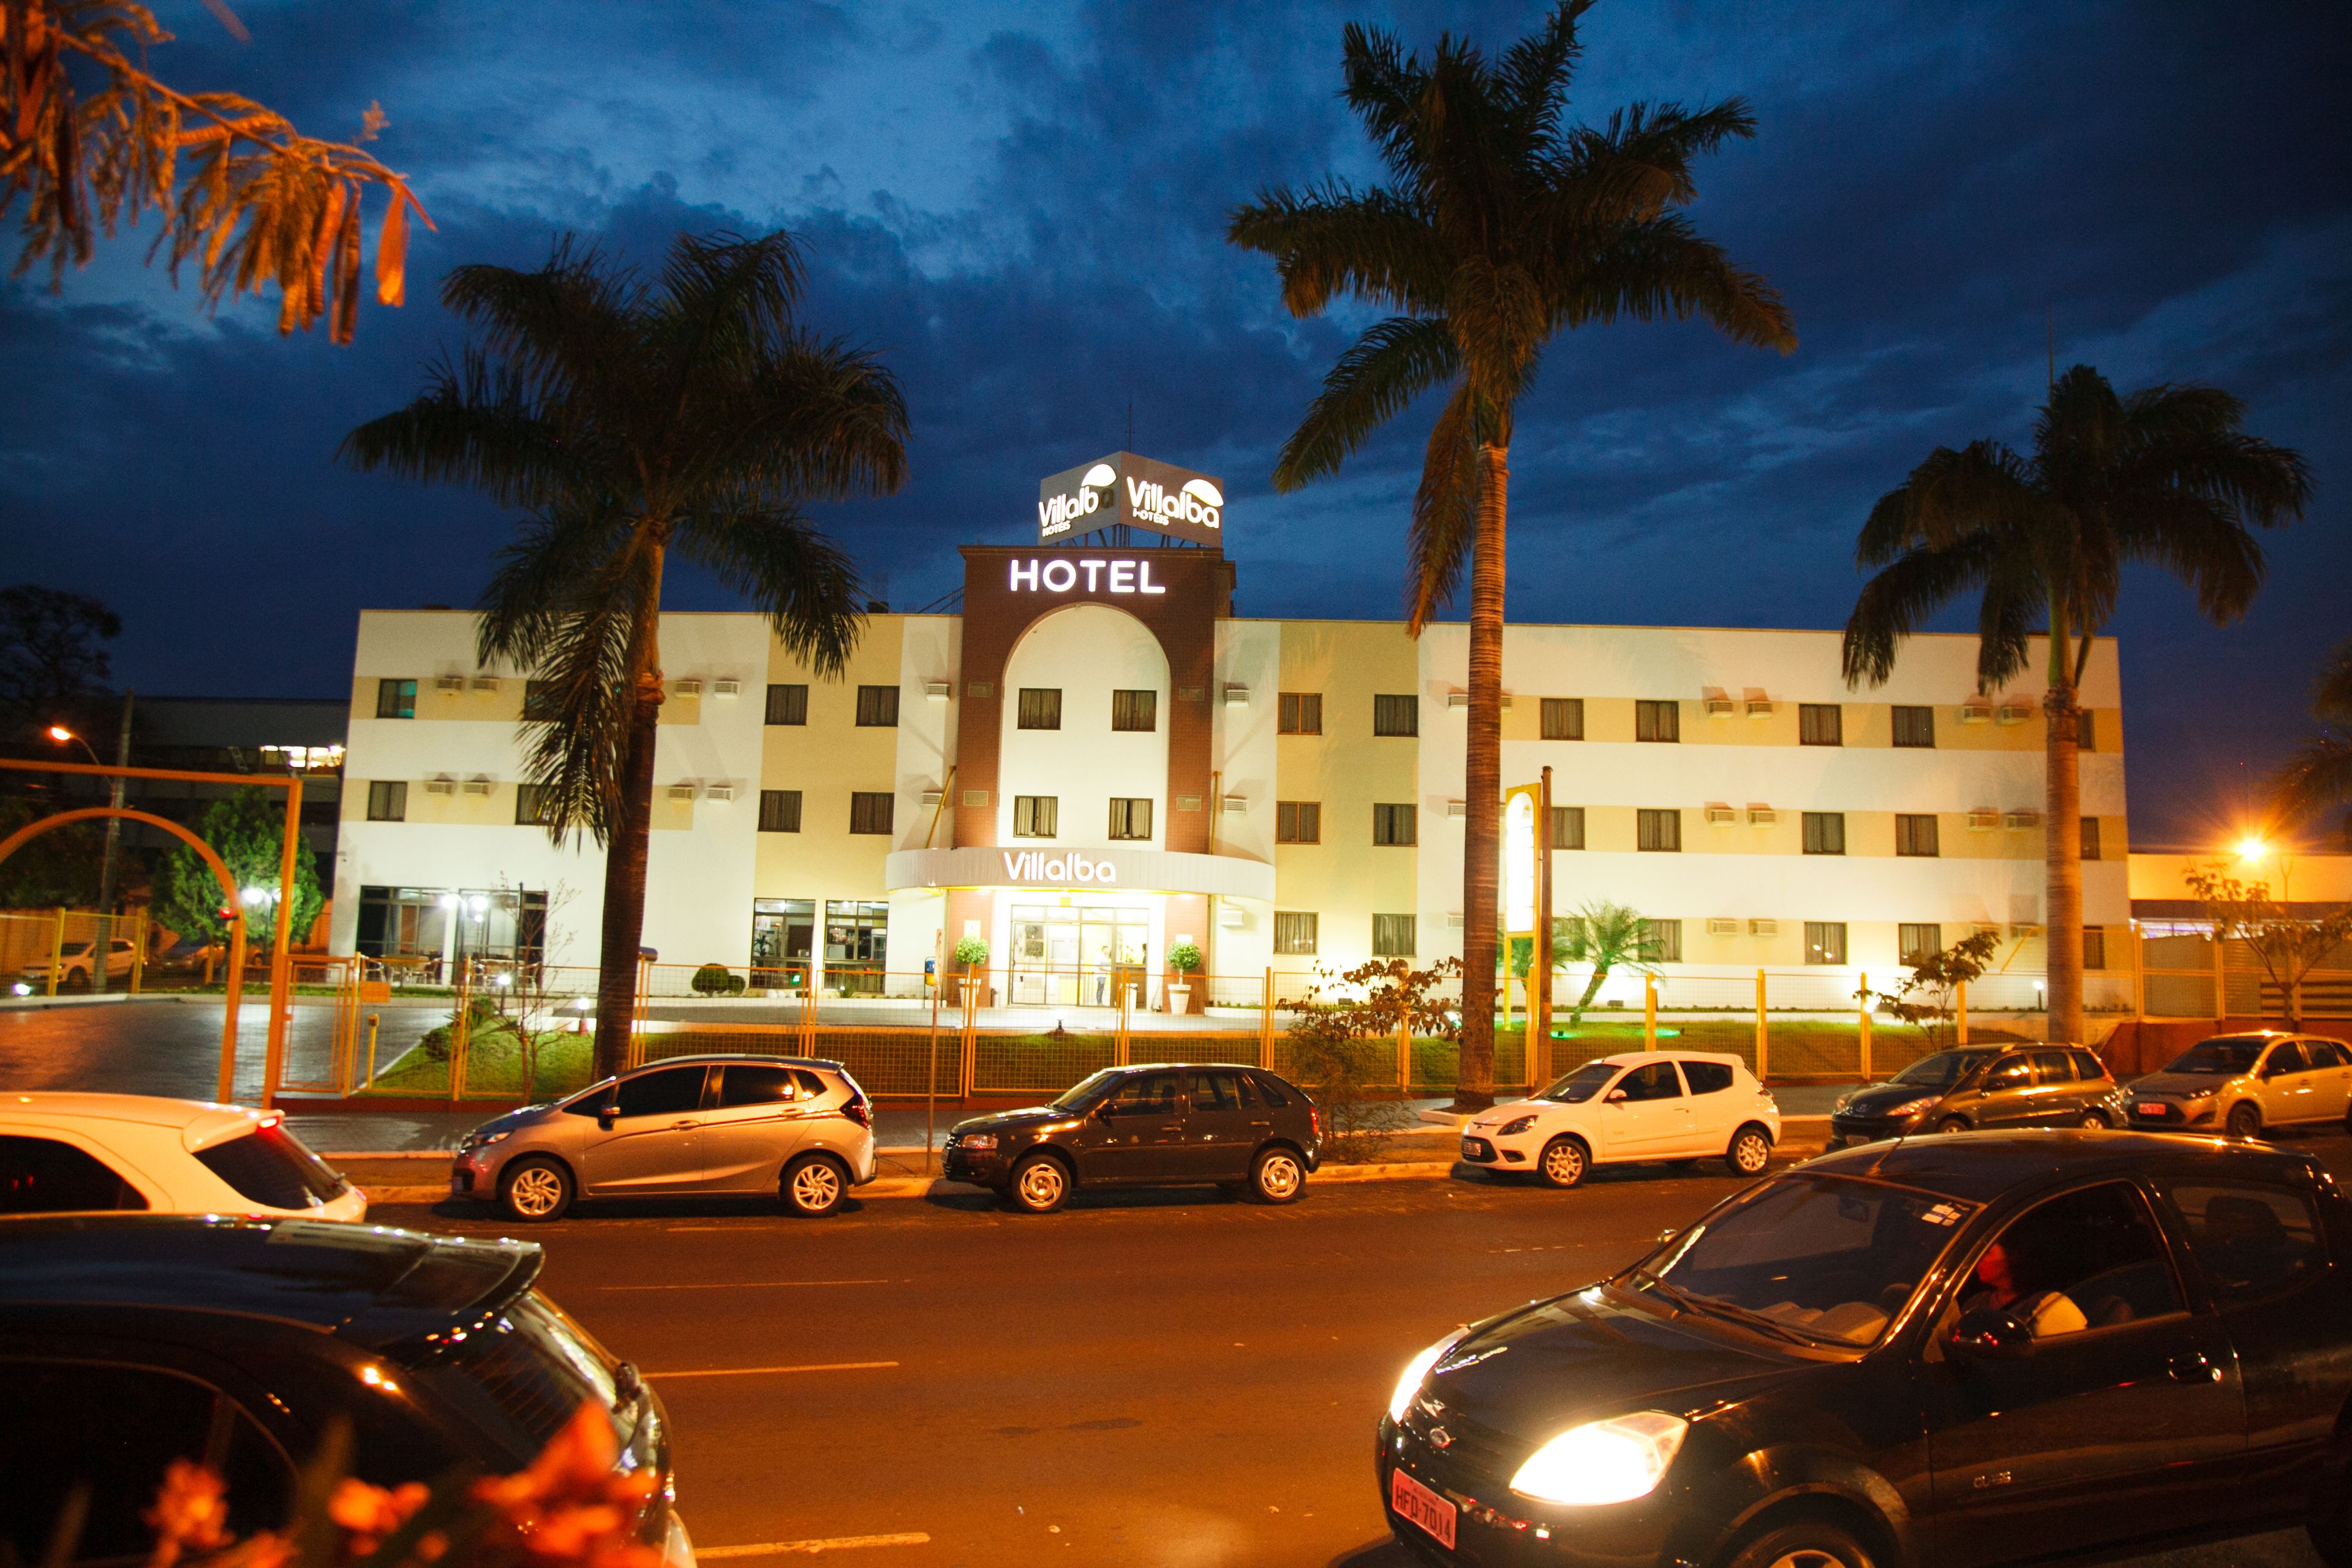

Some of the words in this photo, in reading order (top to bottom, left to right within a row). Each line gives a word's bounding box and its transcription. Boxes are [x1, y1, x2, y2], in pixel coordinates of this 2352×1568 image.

[1126, 476, 1219, 529] Villalba
[1010, 559, 1166, 594] HOTEL
[1004, 852, 1116, 883] Villalba
